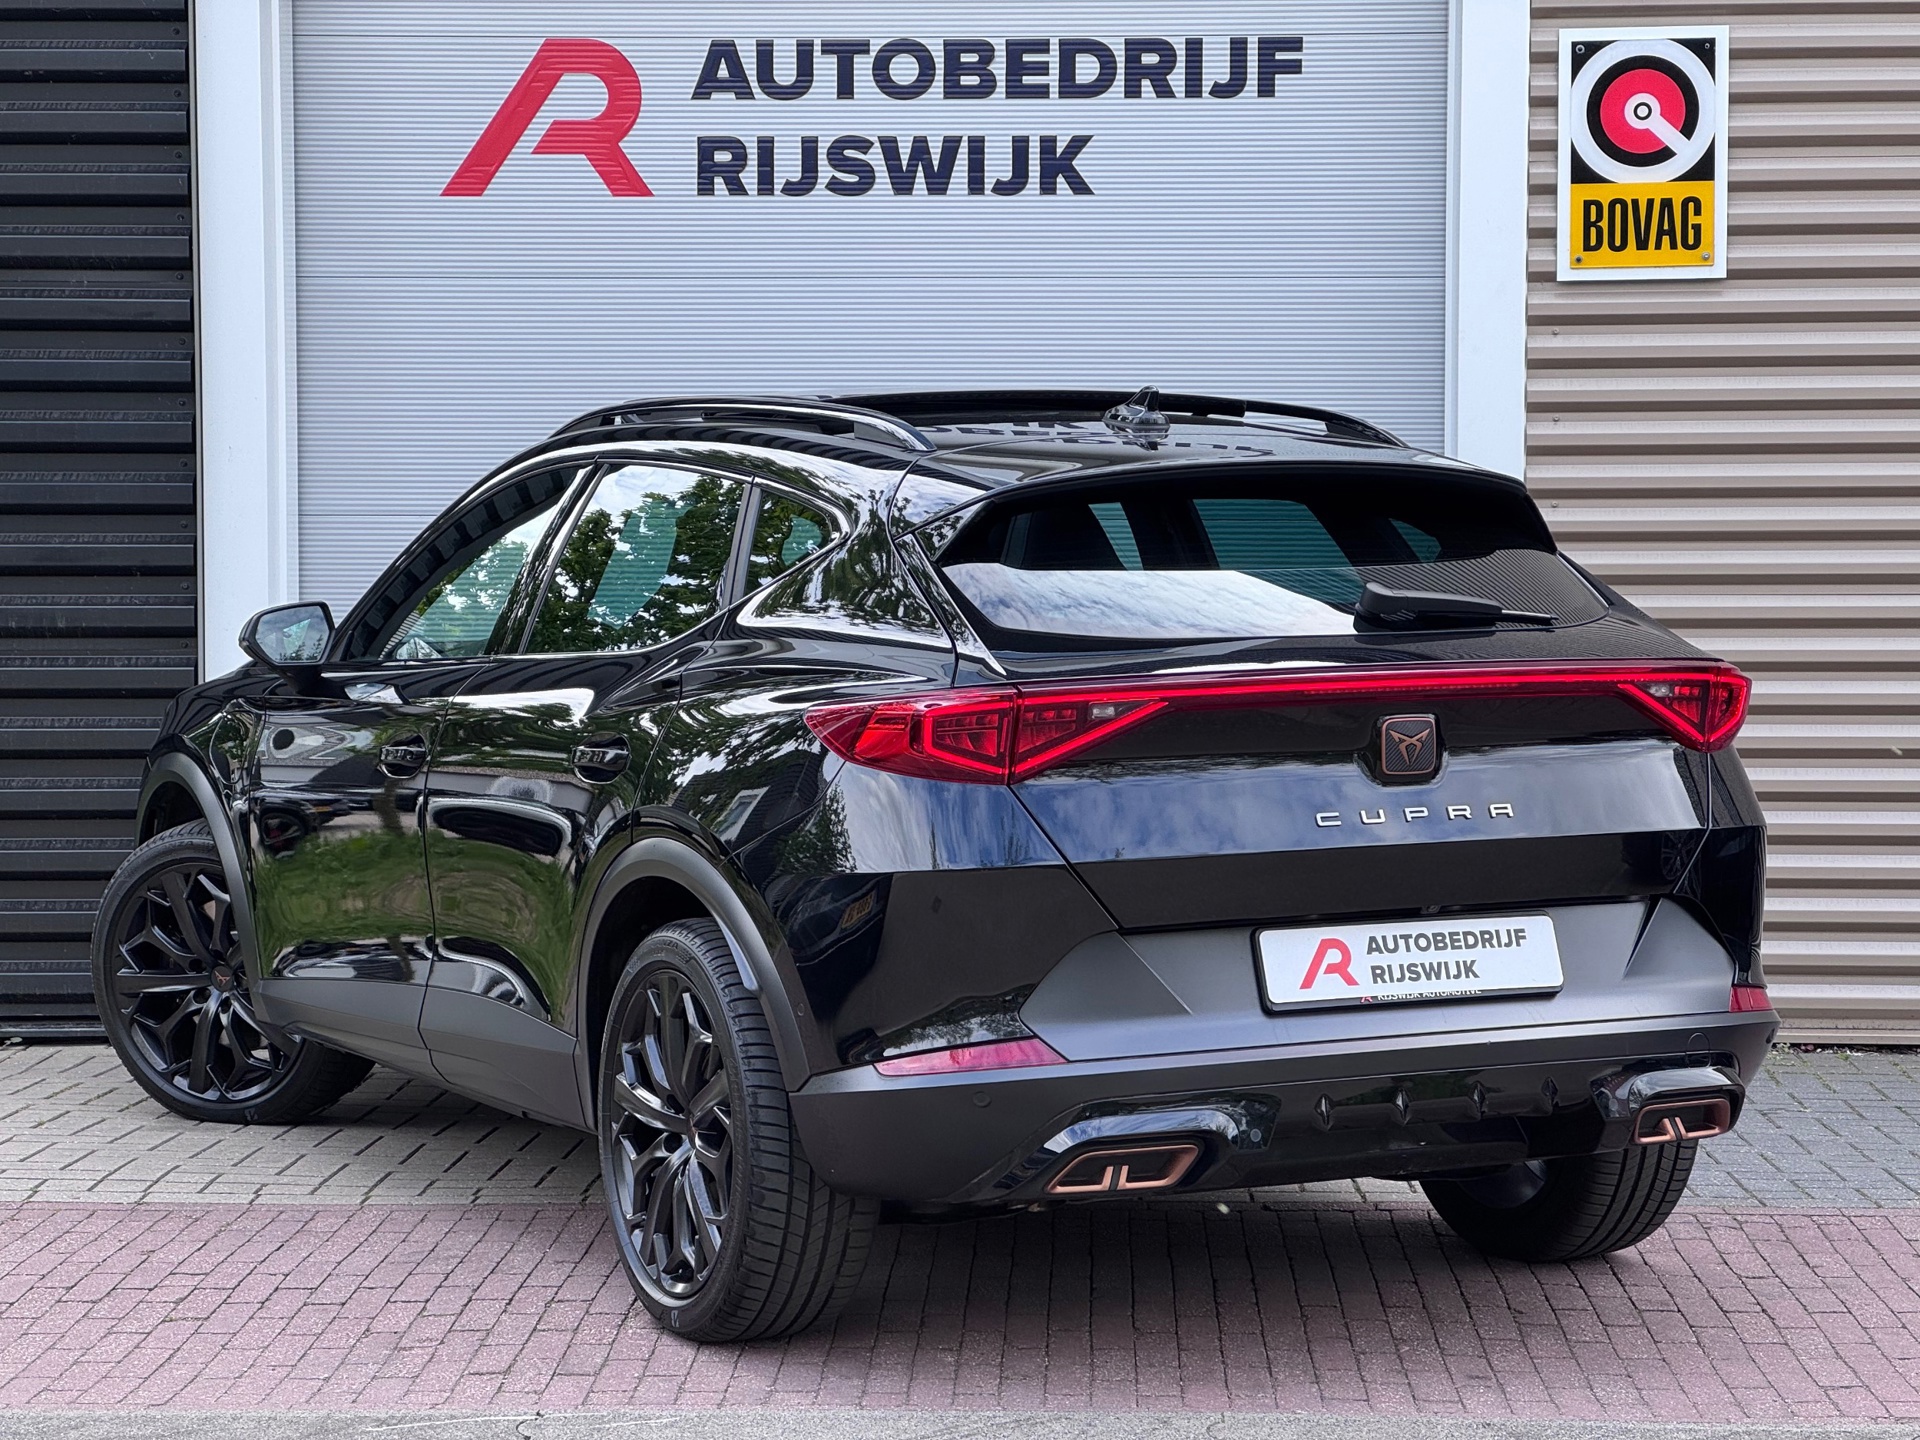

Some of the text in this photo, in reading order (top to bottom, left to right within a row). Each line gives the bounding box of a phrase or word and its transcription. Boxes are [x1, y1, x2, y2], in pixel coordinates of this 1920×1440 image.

[689, 36, 1305, 100] AUTOBEDRIJF
[696, 134, 1096, 197] RIJSWIJK
[1582, 196, 1703, 253] BOVAG
[1316, 803, 1514, 828] CUPRA
[1366, 928, 1528, 956] AUTOBEDRIJF
[1370, 959, 1481, 985] RIJSWIJK
